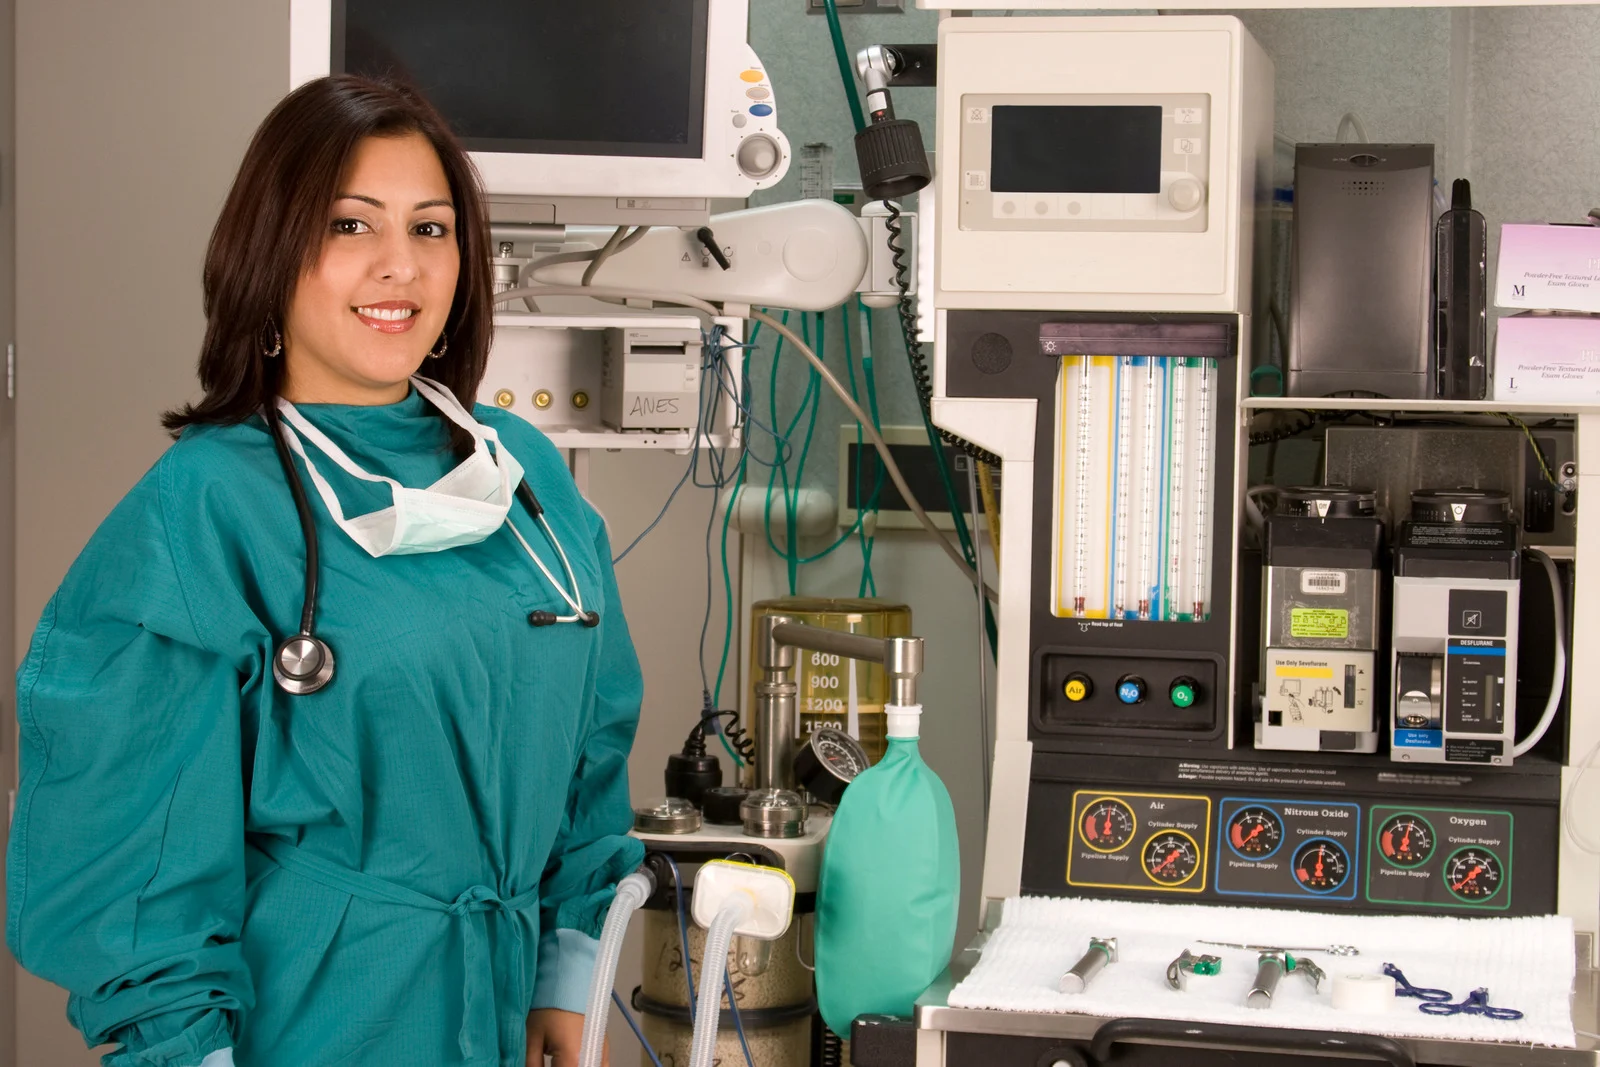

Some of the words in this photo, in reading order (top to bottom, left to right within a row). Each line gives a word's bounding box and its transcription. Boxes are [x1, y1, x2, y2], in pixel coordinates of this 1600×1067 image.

[1524, 272, 1562, 280] Powder-Free
[1512, 284, 1525, 296] M
[1510, 378, 1518, 388] L
[630, 396, 680, 416] ANES
[812, 676, 839, 688] 900
[807, 698, 842, 712] 1200
[1150, 801, 1165, 809] Air
[1284, 808, 1319, 816] Nitrous
[1321, 809, 1349, 818] Oxide
[1450, 816, 1487, 826] Oxygen
